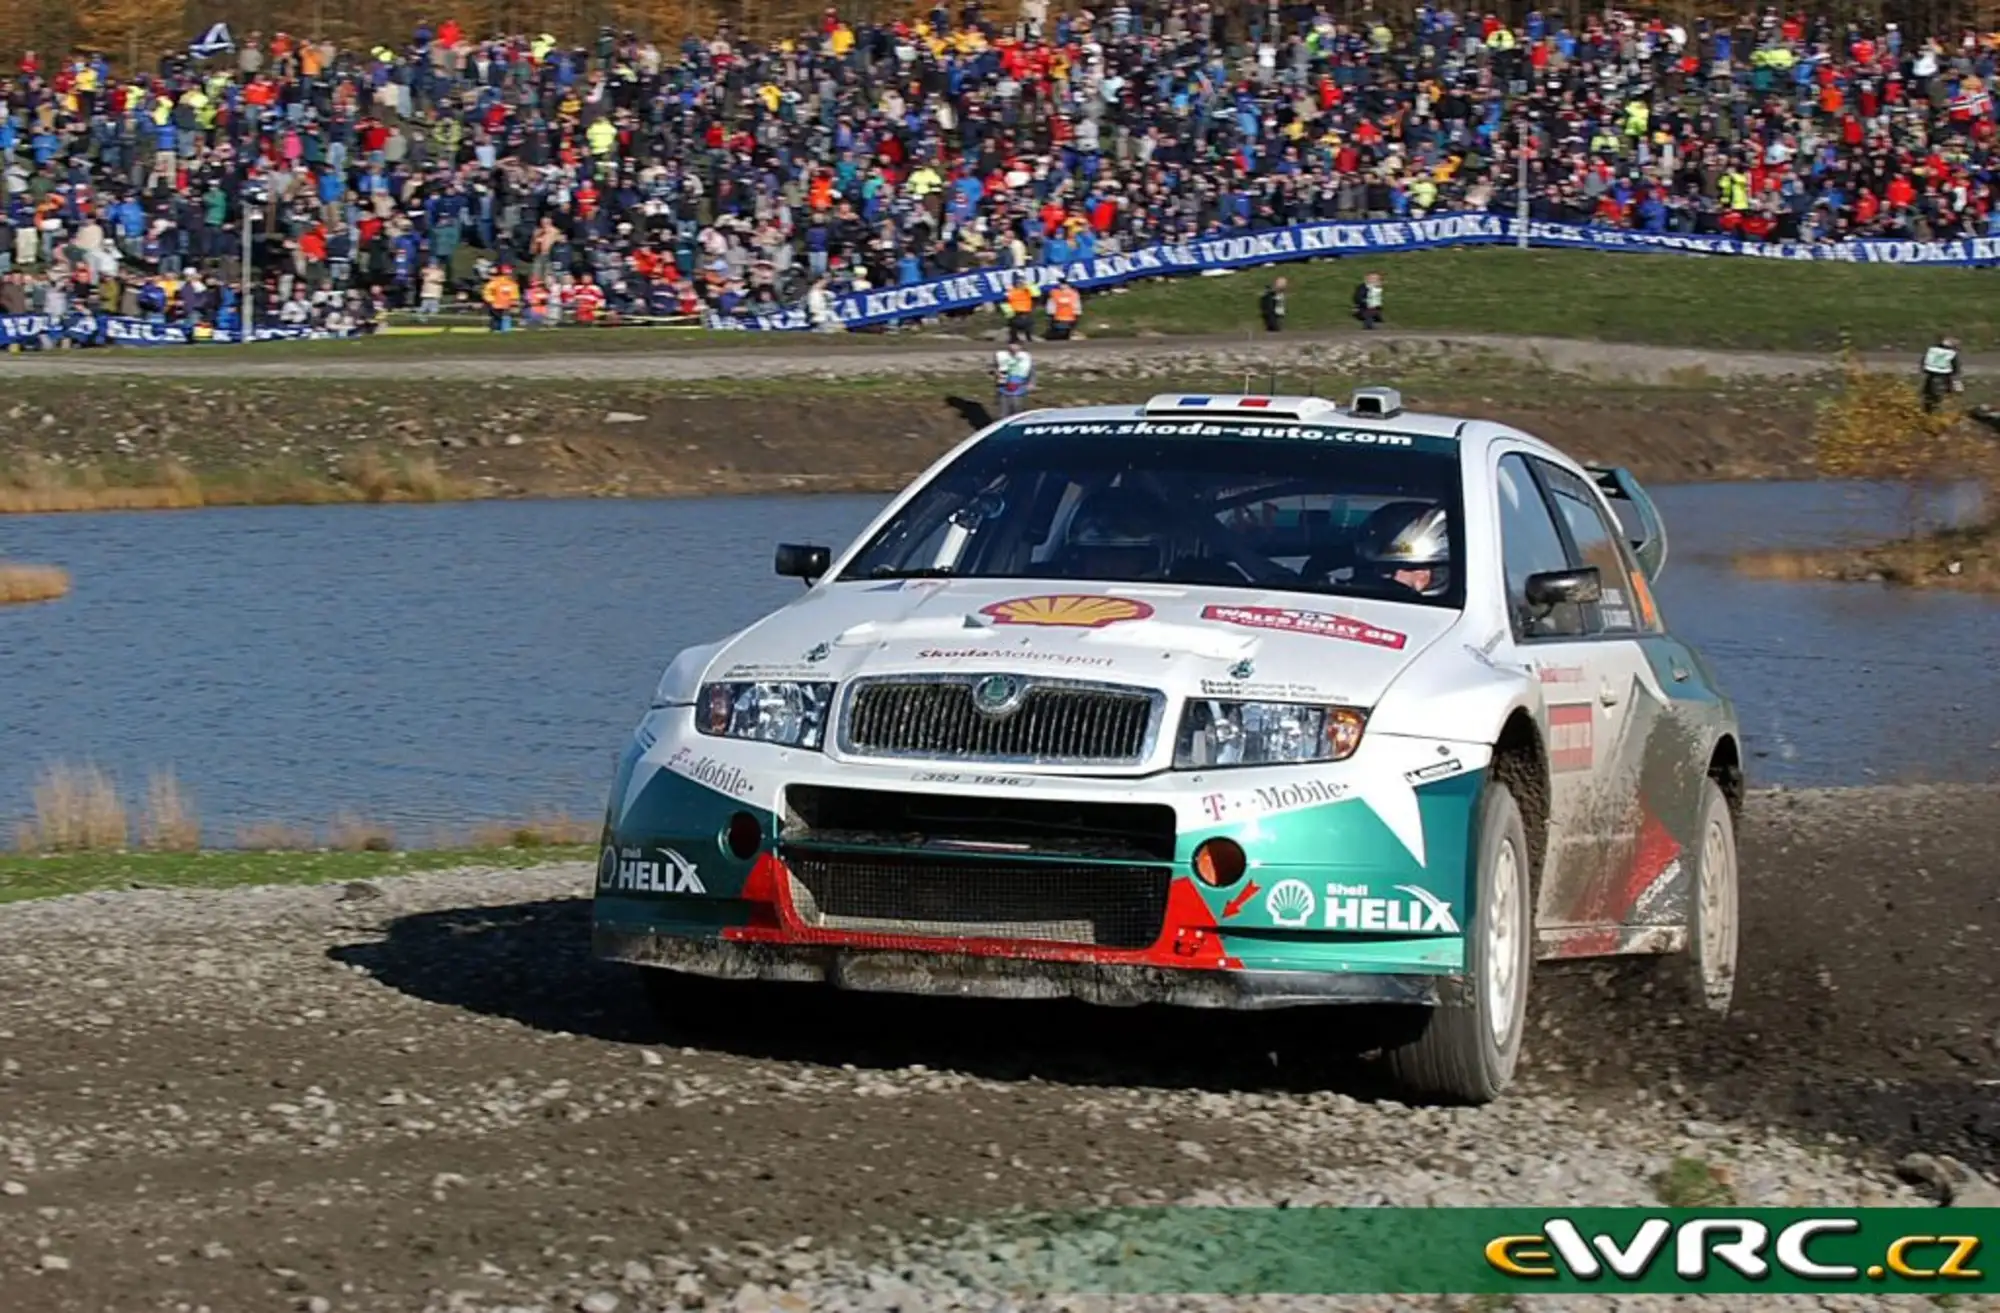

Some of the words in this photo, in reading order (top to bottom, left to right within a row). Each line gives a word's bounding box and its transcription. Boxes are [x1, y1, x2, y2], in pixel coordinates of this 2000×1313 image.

[1199, 231, 1297, 263] VODKA
[1301, 225, 1369, 251] KICK
[1408, 214, 1504, 242] VODKA
[1864, 241, 1966, 263] VODKA
[1022, 421, 1413, 446] www.skoda-auto.com
[1214, 608, 1292, 626] WALES
[1296, 618, 1361, 636] RALLY
[618, 848, 707, 894] HELIX
[1326, 882, 1369, 896] Shell
[1323, 884, 1461, 932] HELIX
